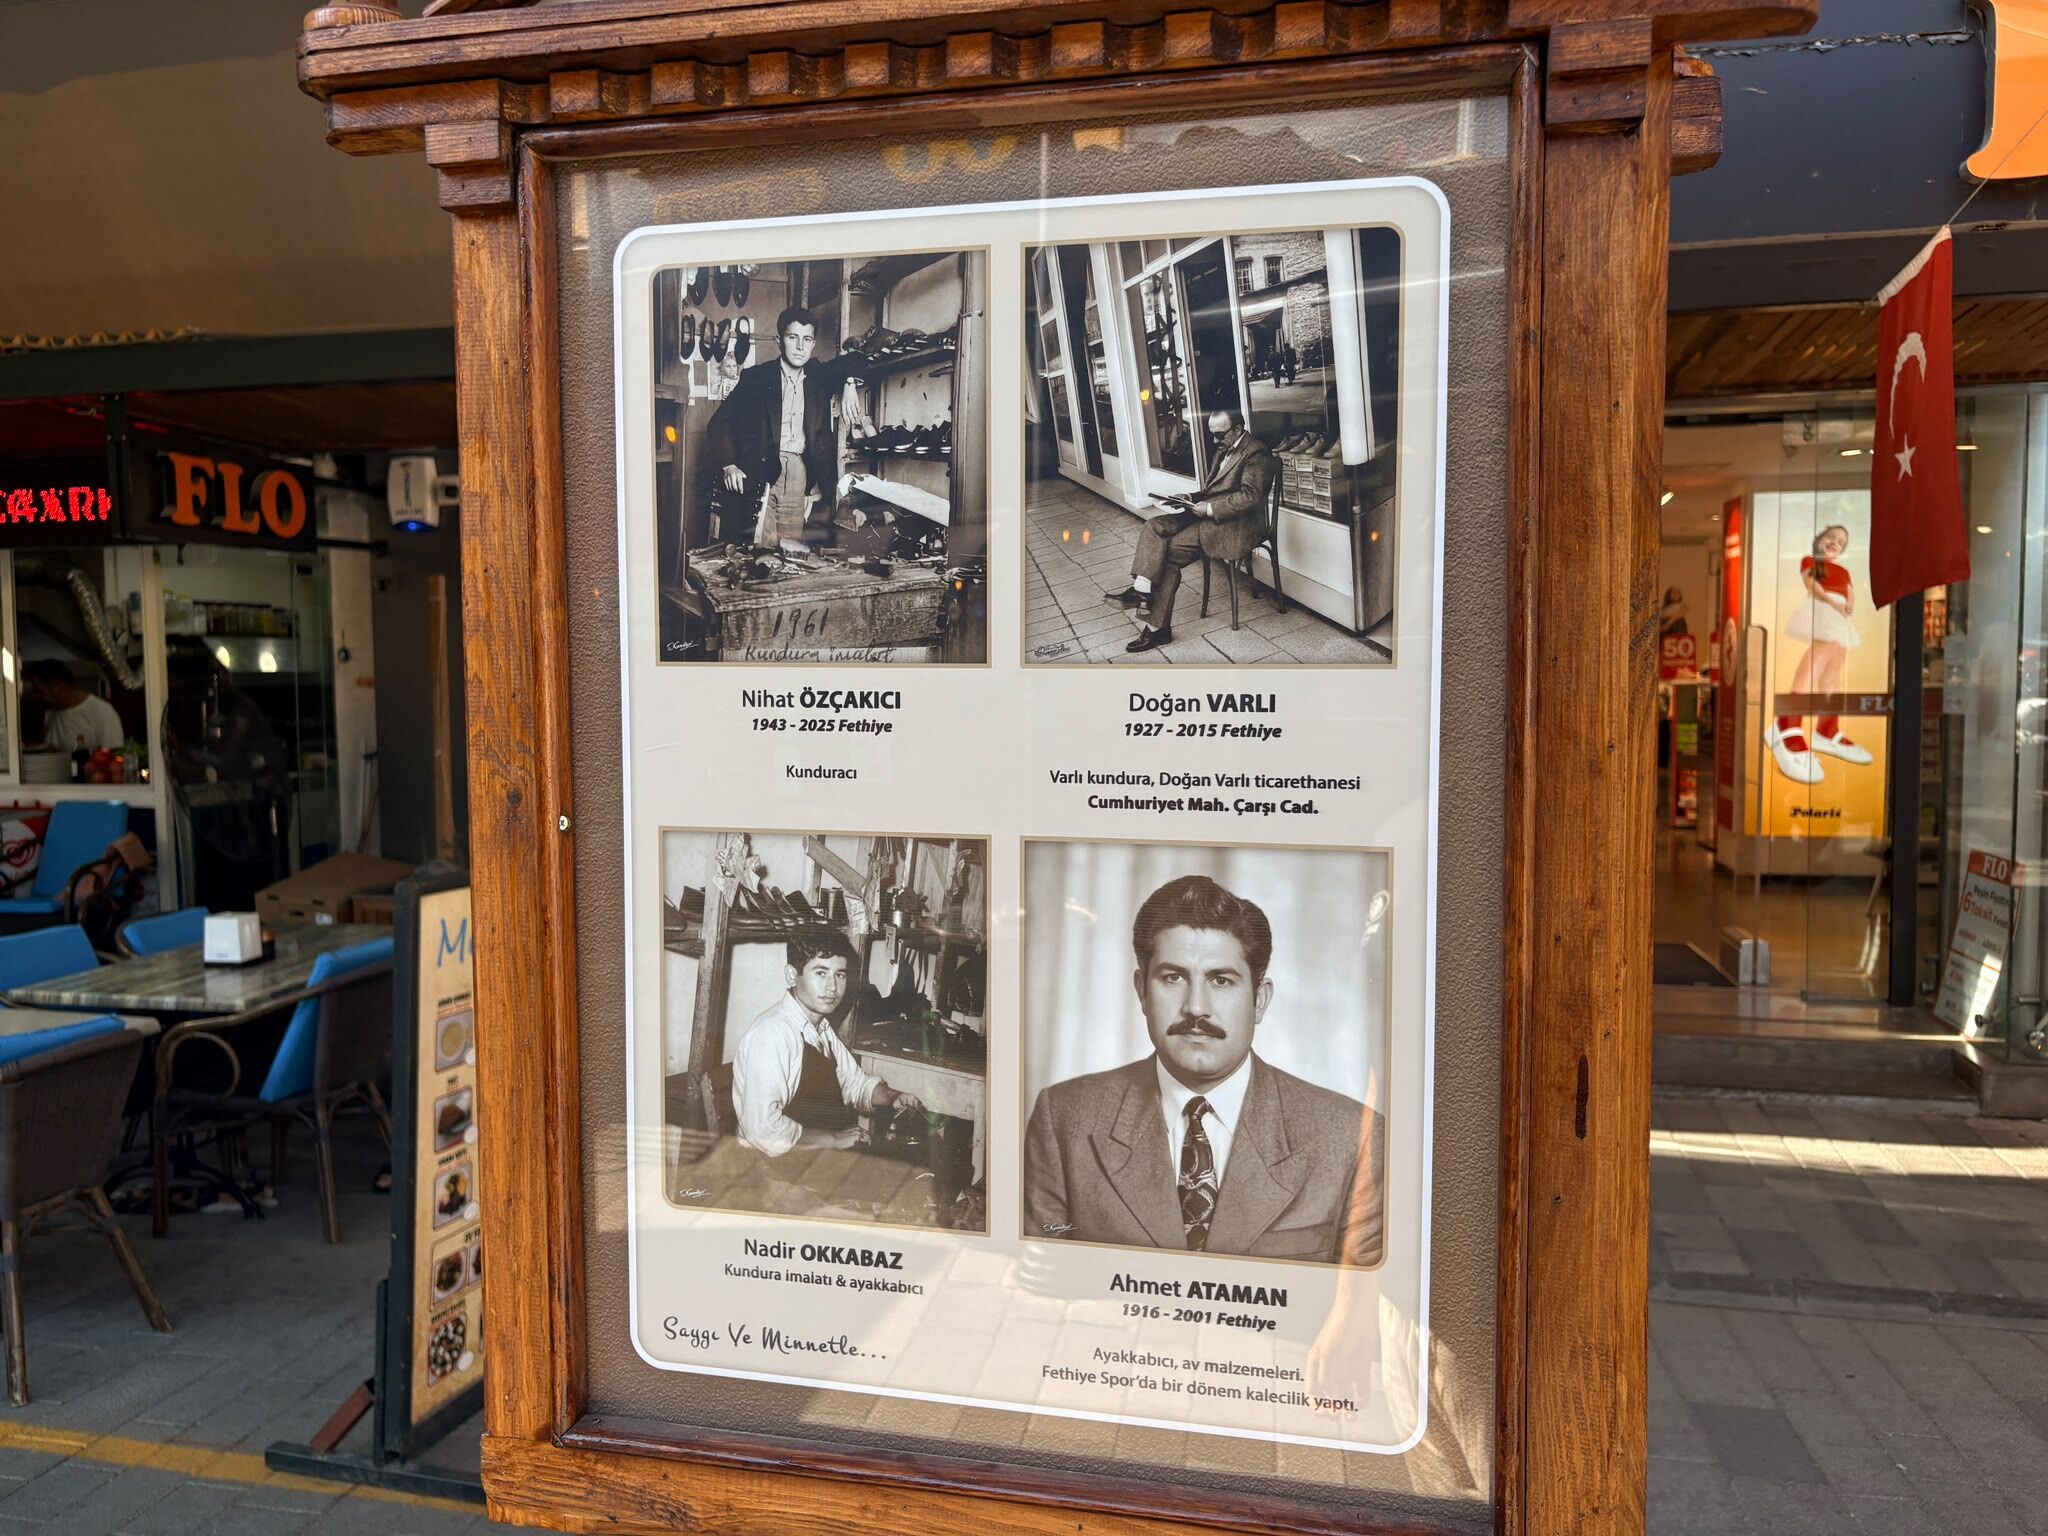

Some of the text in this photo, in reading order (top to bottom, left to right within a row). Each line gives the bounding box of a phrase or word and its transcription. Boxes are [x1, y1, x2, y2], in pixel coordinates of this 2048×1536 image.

[168, 452, 306, 538] FLO
[771, 608, 829, 639] 1961
[1664, 638, 1693, 658] 50
[743, 687, 900, 713] Nihat ÖZÇAKICI
[1130, 693, 1275, 716] Doğan VARLI
[753, 719, 786, 731] 1943
[799, 719, 835, 731] 2025
[838, 719, 892, 736] Fethiye
[1125, 723, 1163, 736] 1927
[1176, 724, 1217, 737] 2015
[1221, 724, 1282, 741] Fethiye
[787, 765, 856, 779] Kunduracı
[1050, 770, 1360, 789] Varlı kundura, Doğan Varlı ticarethanesi
[1088, 795, 1318, 816] Cumhuriyet Mah. Çarşı Cad.
[1983, 854, 2007, 881] FLO
[437, 917, 474, 967] M
[745, 1239, 903, 1270] Nadir OKKABAZ
[725, 1264, 922, 1294] Kundura imalatı & ayakkabıcı
[1110, 1274, 1287, 1307] Ahmet ATAMAN
[1123, 1304, 1160, 1318] 1916
[1173, 1309, 1211, 1323] 2001
[1217, 1313, 1276, 1332] Fethiye
[664, 1317, 885, 1359] Saygı Ve Minnetle...
[1093, 1348, 1304, 1381] Ayakkabıcı, av malzemeleri.
[1043, 1365, 1096, 1384] Fethiye
[1162, 1378, 1183, 1392] bir
[1187, 1381, 1241, 1399] dönem
[1247, 1387, 1310, 1406] kalecilik
[1314, 1398, 1358, 1412] yaptı.
